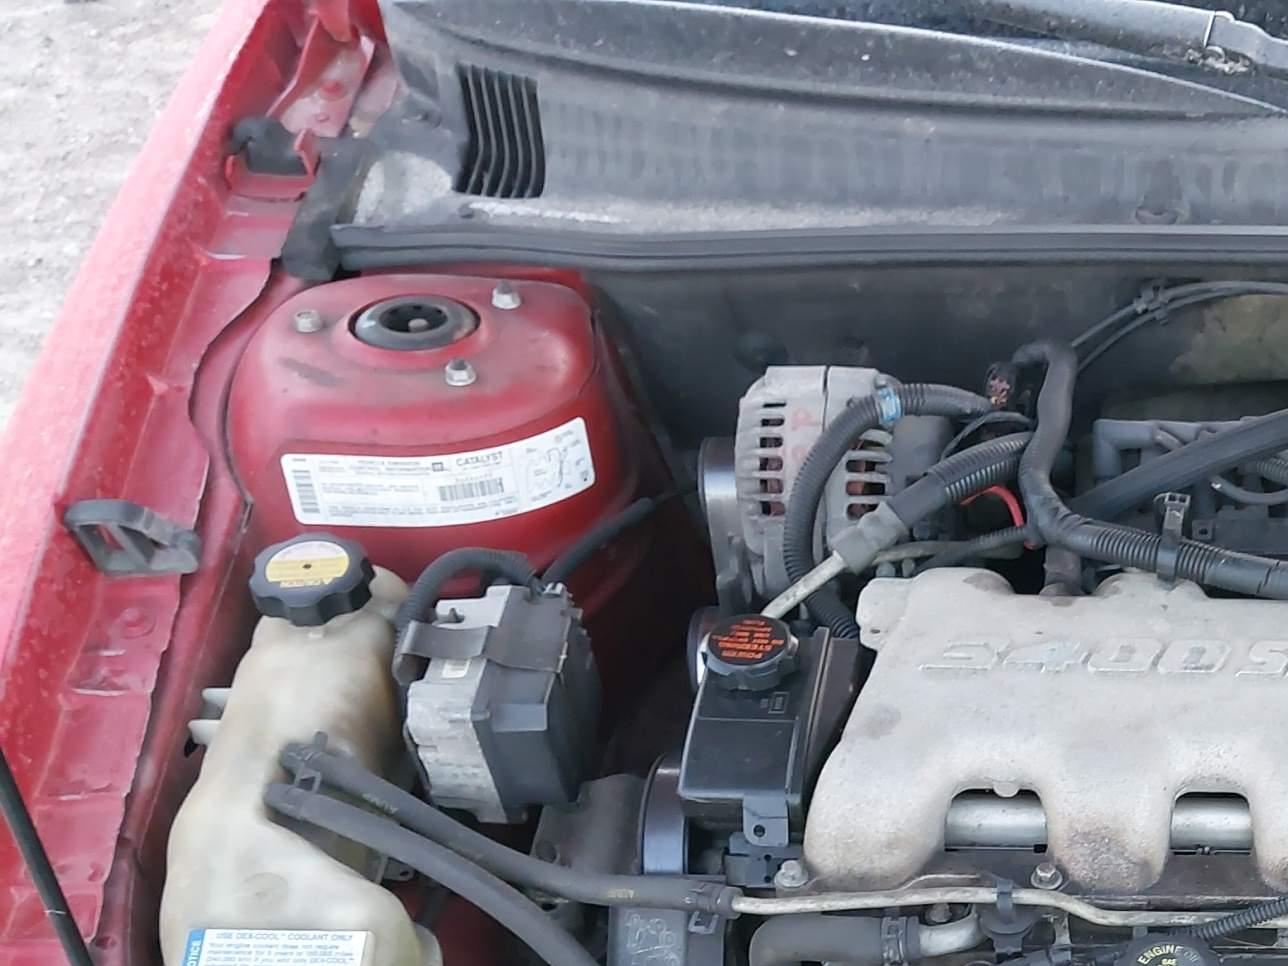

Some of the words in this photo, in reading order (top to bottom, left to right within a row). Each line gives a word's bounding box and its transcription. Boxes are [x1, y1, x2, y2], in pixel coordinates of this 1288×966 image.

[456, 451, 502, 466] CATALYST
[721, 650, 763, 659] POWER
[919, 639, 1233, 674] 3400
[1137, 945, 1184, 965] ENGINE
[1184, 951, 1199, 962] OIL
